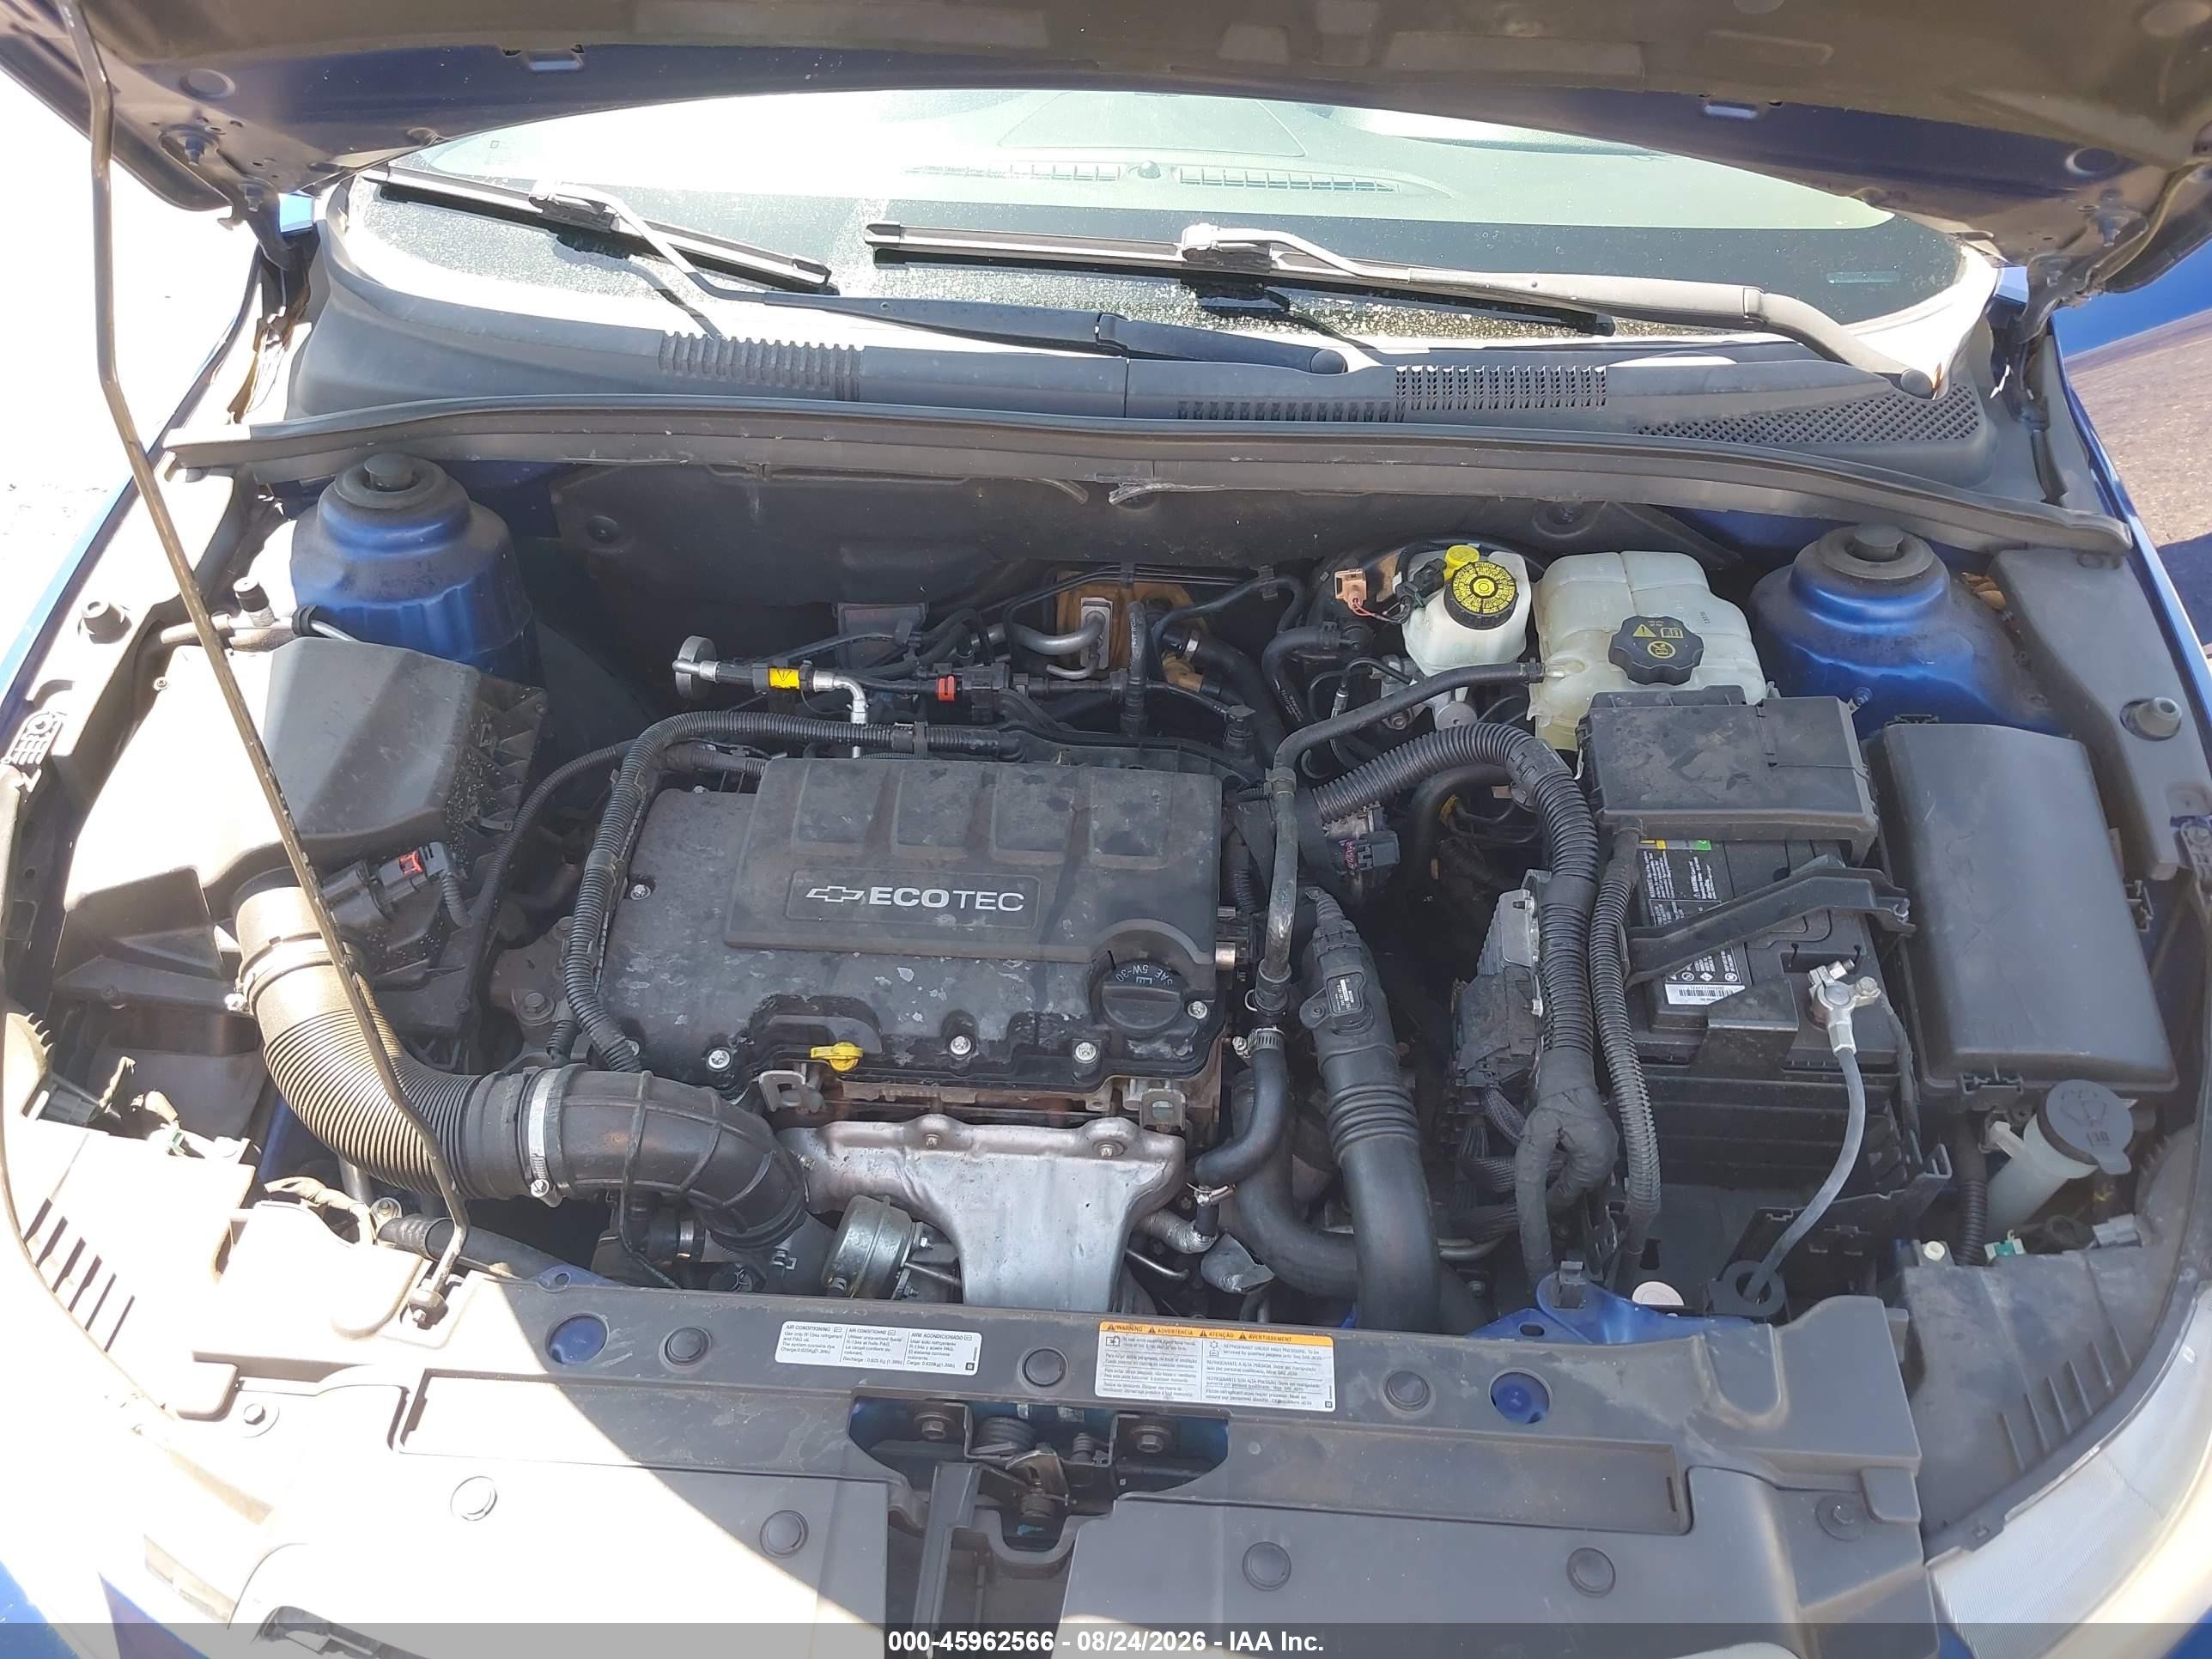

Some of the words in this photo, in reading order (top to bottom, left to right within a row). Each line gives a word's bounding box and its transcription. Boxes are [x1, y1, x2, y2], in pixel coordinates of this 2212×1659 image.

[869, 887, 1024, 911] ECOTEC
[1116, 965, 1149, 981] 5W-30
[1155, 969, 1173, 986] SAE
